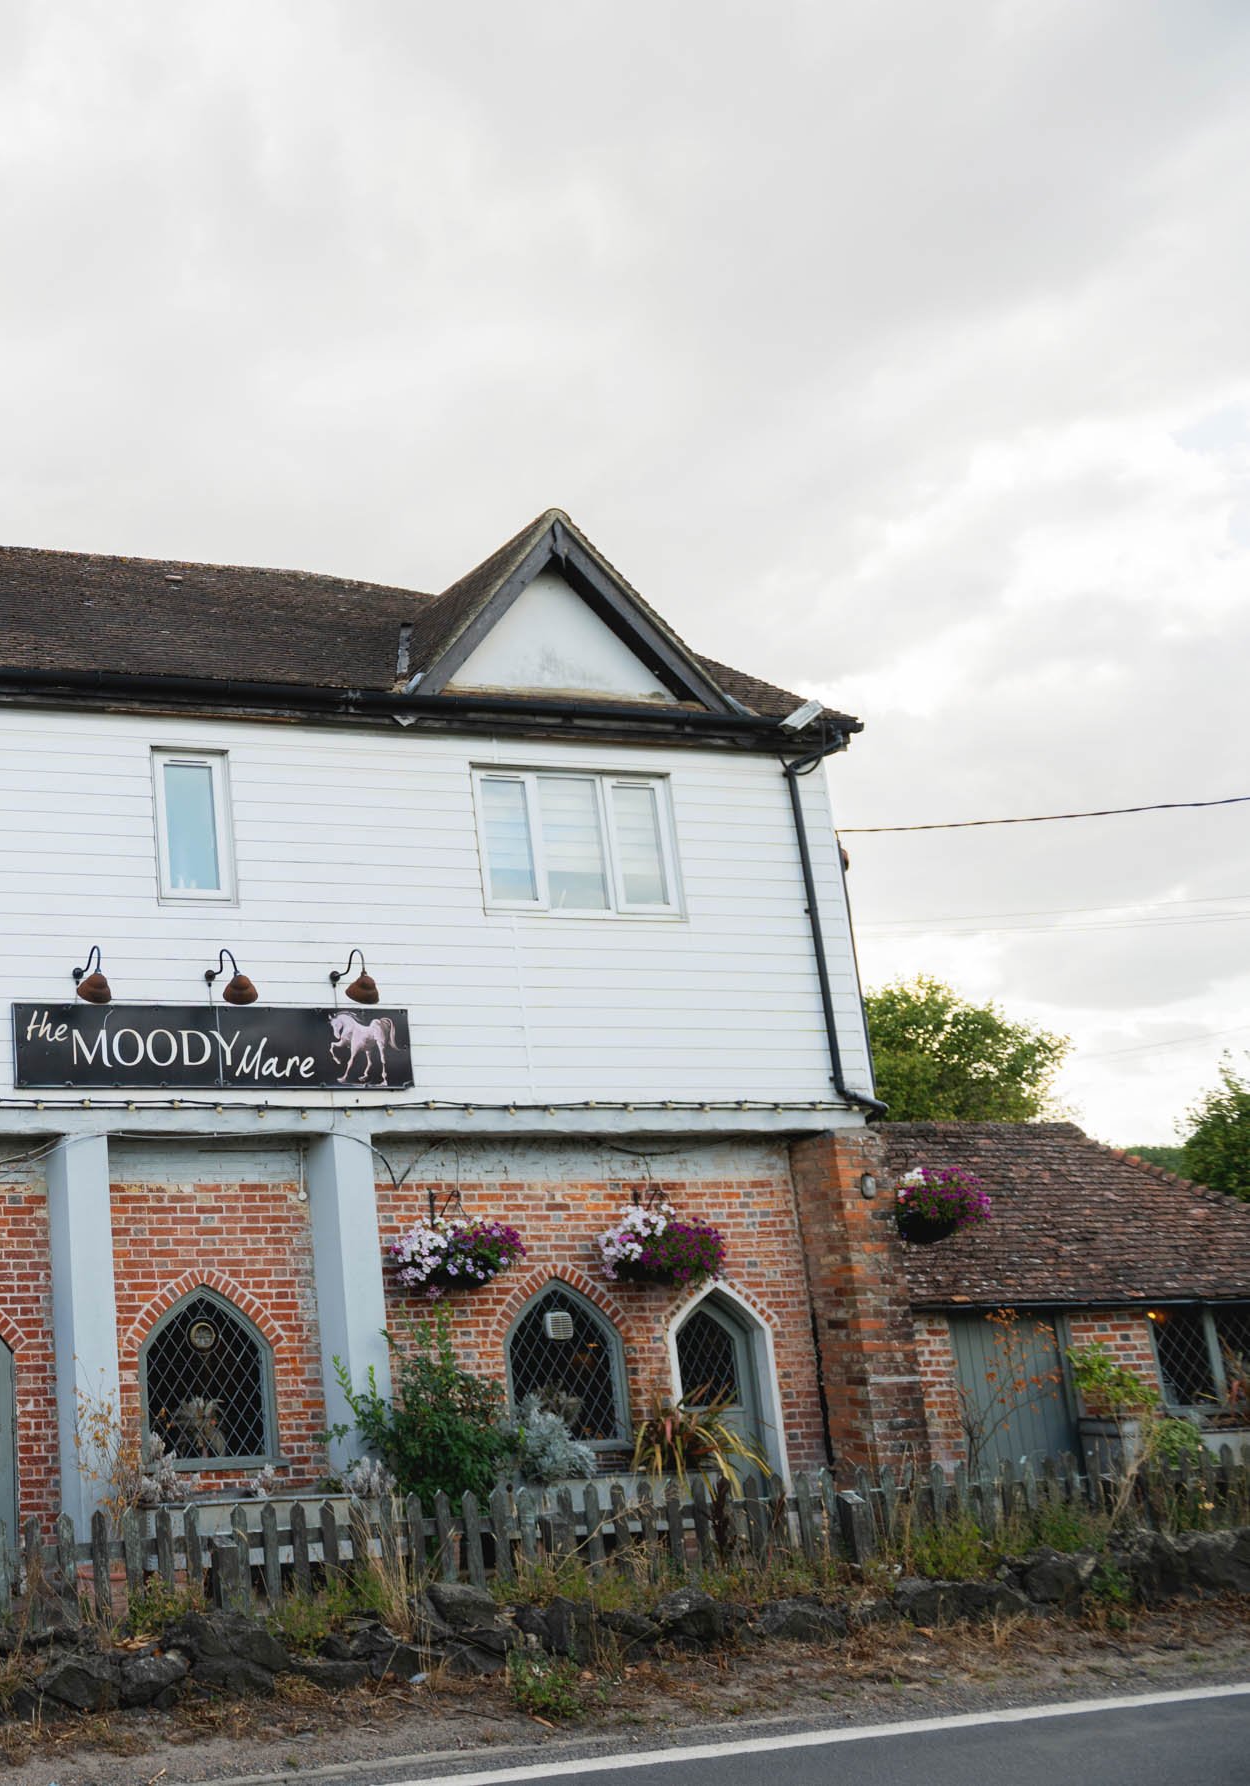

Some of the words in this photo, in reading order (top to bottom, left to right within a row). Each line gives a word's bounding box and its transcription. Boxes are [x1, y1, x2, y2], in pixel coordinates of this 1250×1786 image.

[26, 1009, 69, 1042] the
[71, 1028, 240, 1068] MOODY
[235, 1036, 315, 1080] Mare
